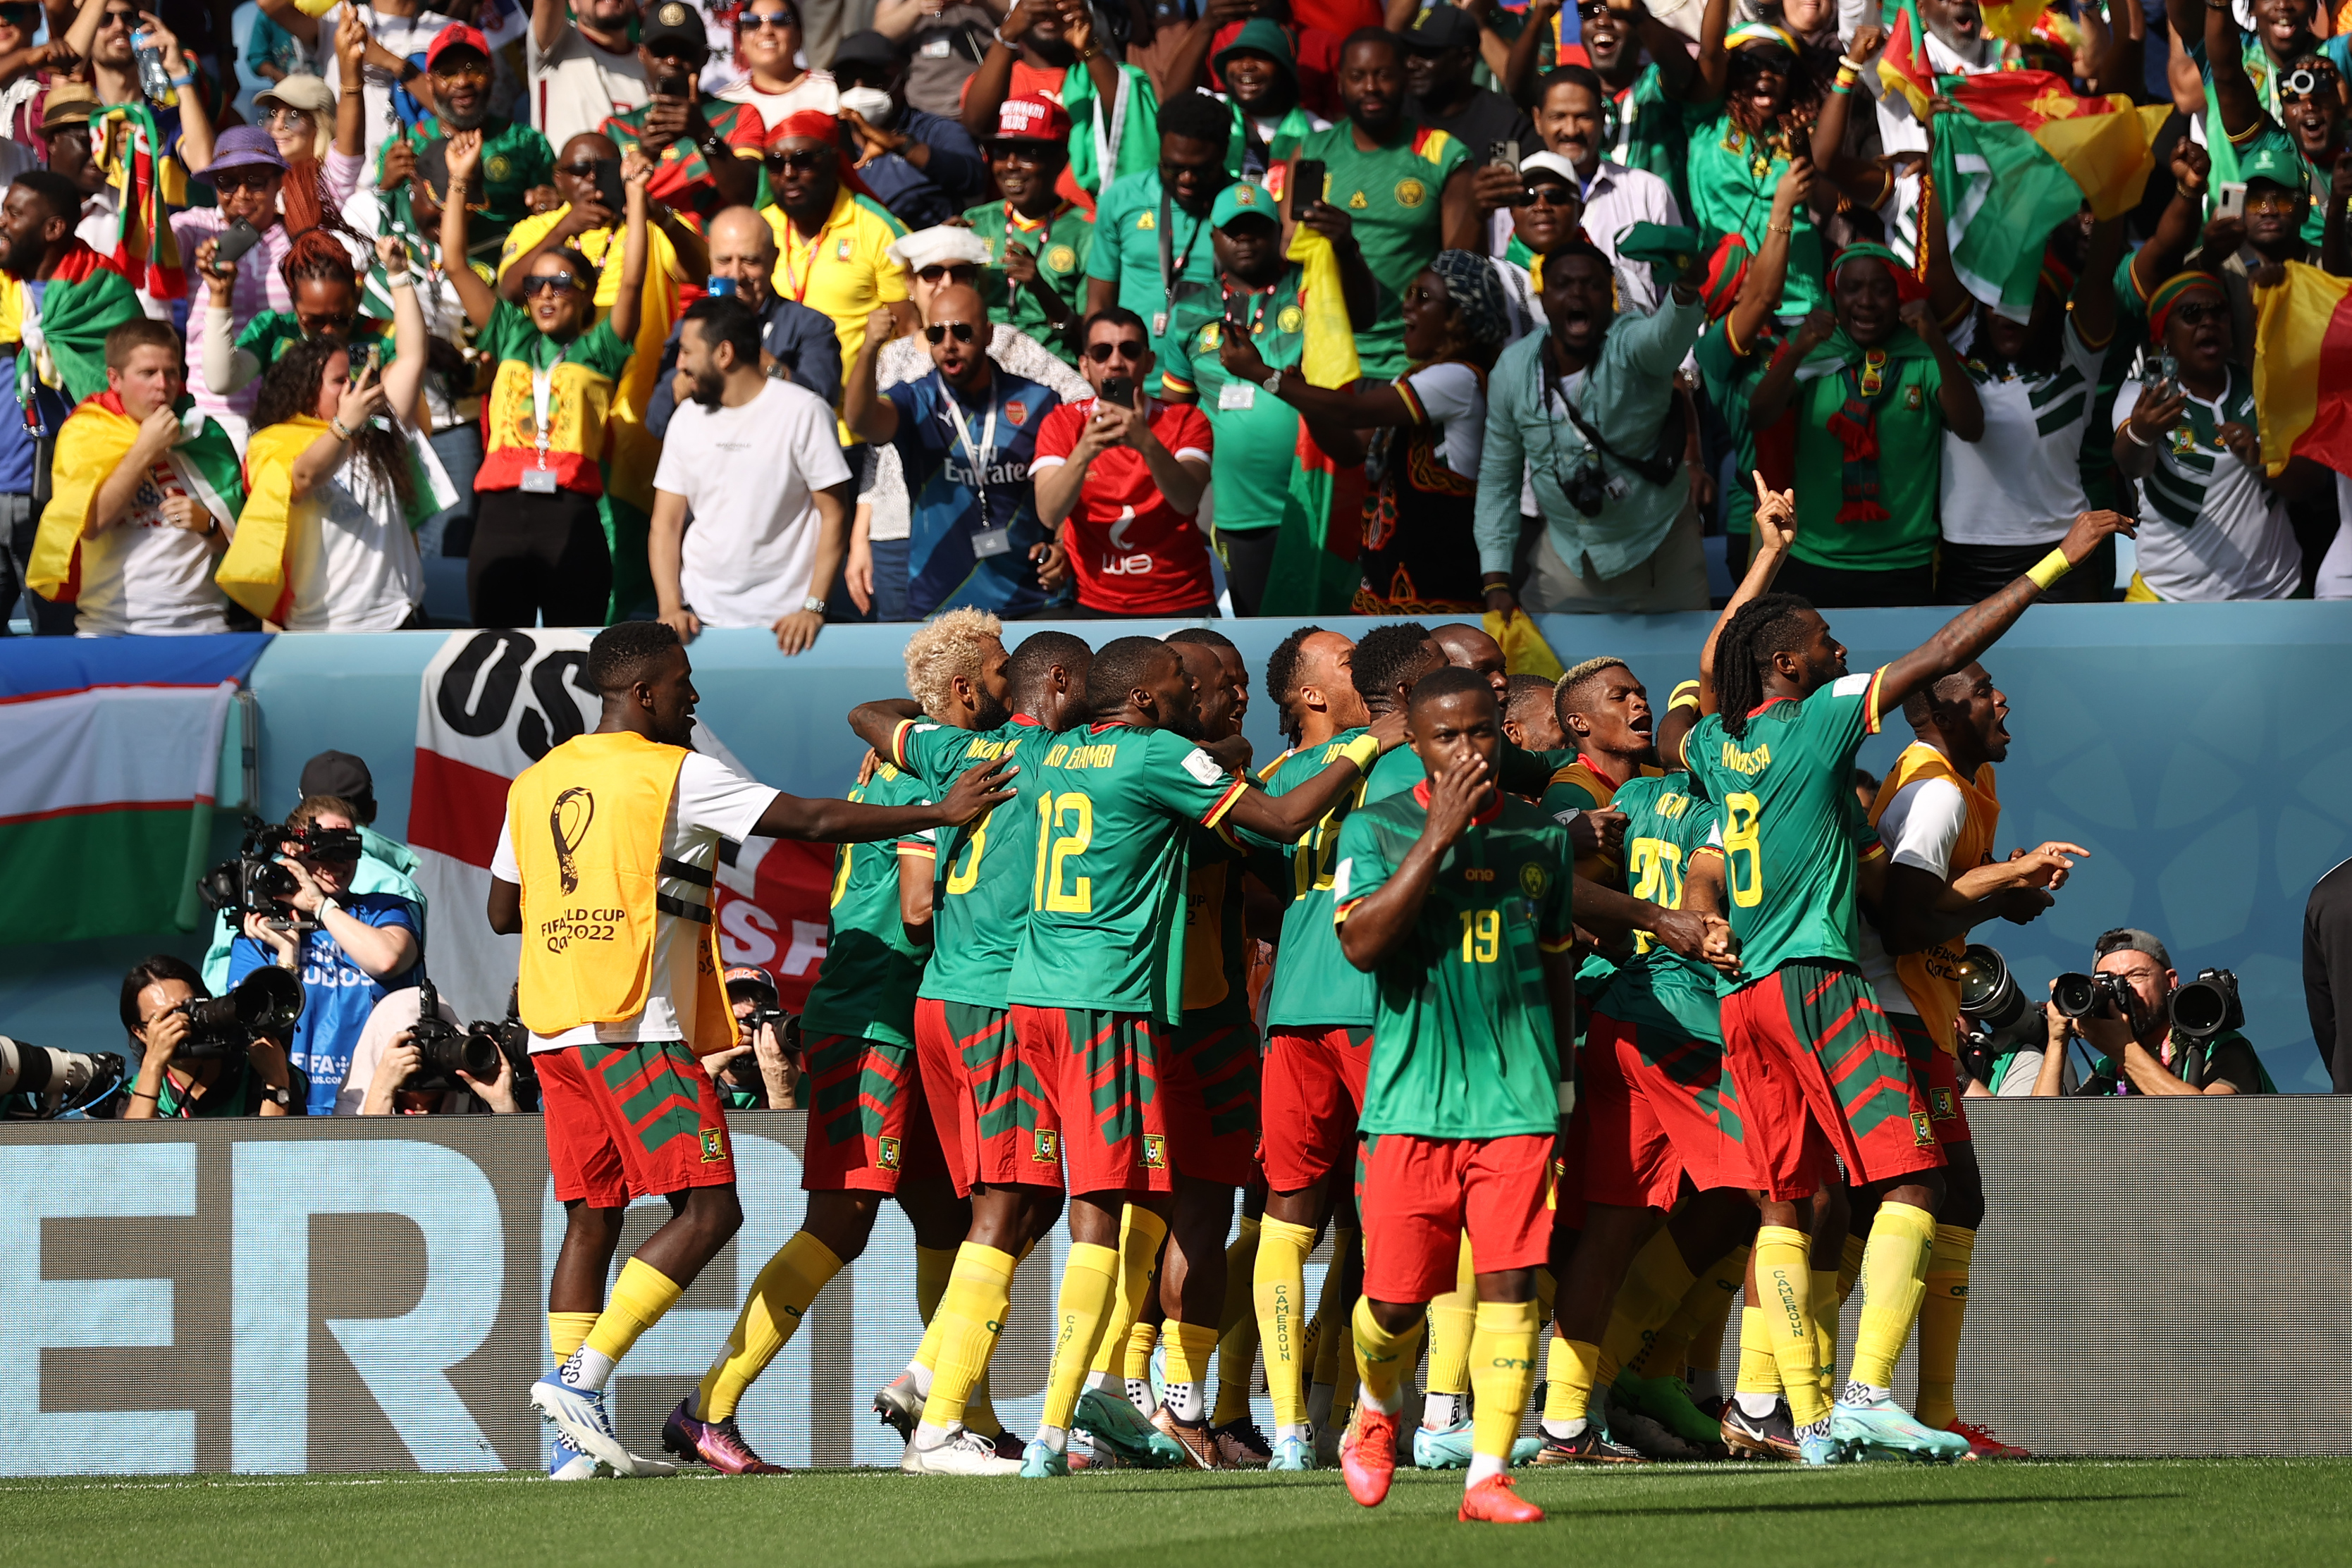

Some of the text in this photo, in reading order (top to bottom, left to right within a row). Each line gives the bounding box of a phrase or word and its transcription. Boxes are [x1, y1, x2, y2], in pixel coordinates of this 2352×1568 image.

[944, 457, 1027, 486] Emrate
[1043, 743, 1069, 767] KO
[1034, 789, 1093, 913] 12
[1723, 791, 1763, 908] 8
[1465, 868, 1495, 882] one
[1187, 894, 1206, 908] UP
[1630, 837, 1683, 955] 20
[541, 917, 567, 937] FIFA
[591, 908, 625, 922] CUP
[567, 924, 615, 942] 2022
[1459, 909, 1500, 963] 19
[291, 1052, 335, 1075] FIFA
[931, 1289, 948, 1323] EROUN
[1275, 1285, 1291, 1362] CAMEROUN
[1773, 1270, 1804, 1338] CAMEROUN
[1425, 1305, 1437, 1354] MEROUN
[1048, 1315, 1076, 1388] CAMEROUN
